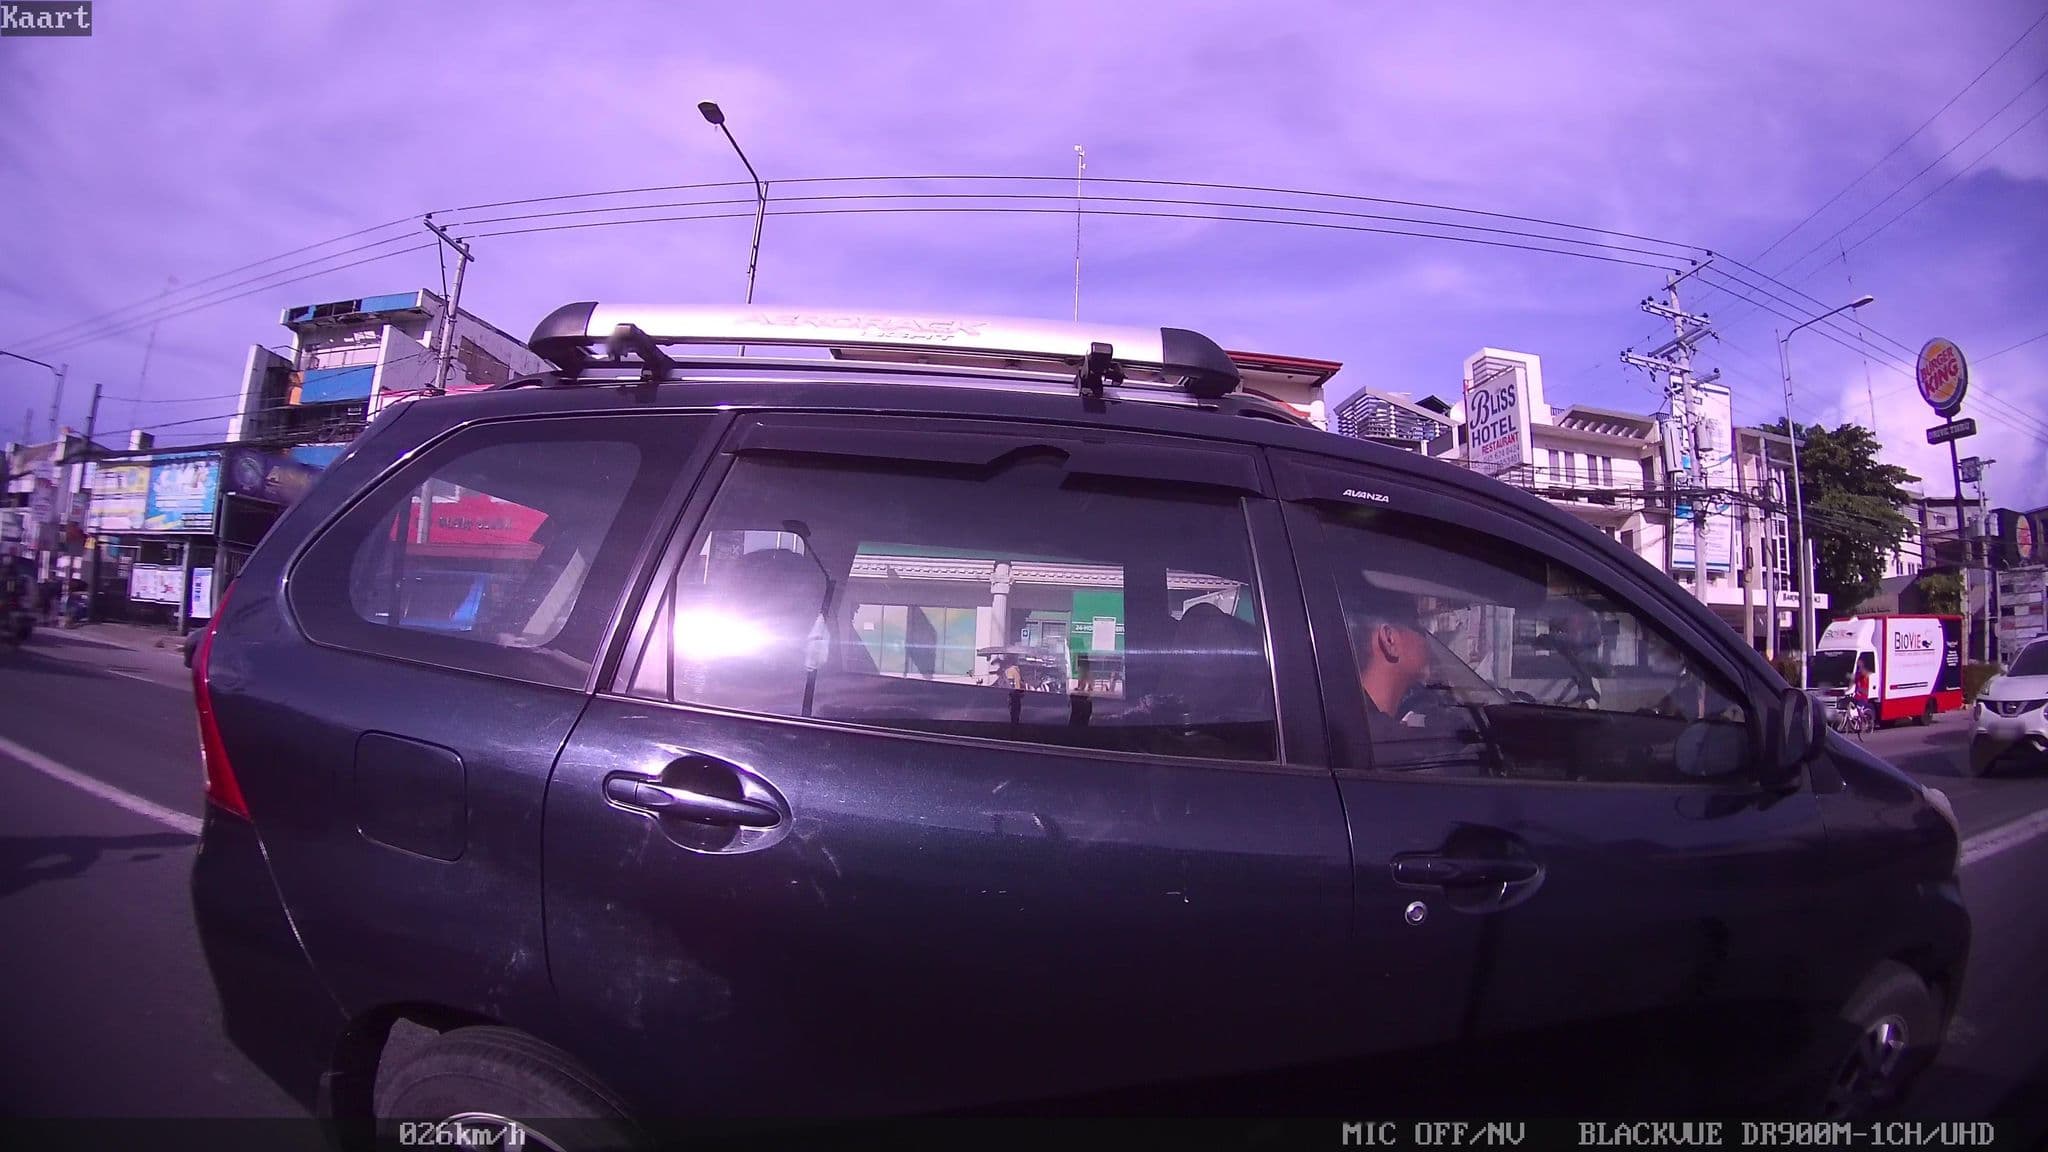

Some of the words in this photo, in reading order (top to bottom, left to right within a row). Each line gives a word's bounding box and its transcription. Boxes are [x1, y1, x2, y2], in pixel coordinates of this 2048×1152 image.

[1921, 346, 1954, 383] BURGER
[1924, 358, 1959, 398] KING
[1470, 384, 1516, 430] BLISS
[1471, 415, 1517, 449] HOTEL
[1481, 431, 1519, 455] RESTAURANT
[1342, 489, 1390, 503] AVANZA
[1894, 632, 1921, 650] BIOVIE
